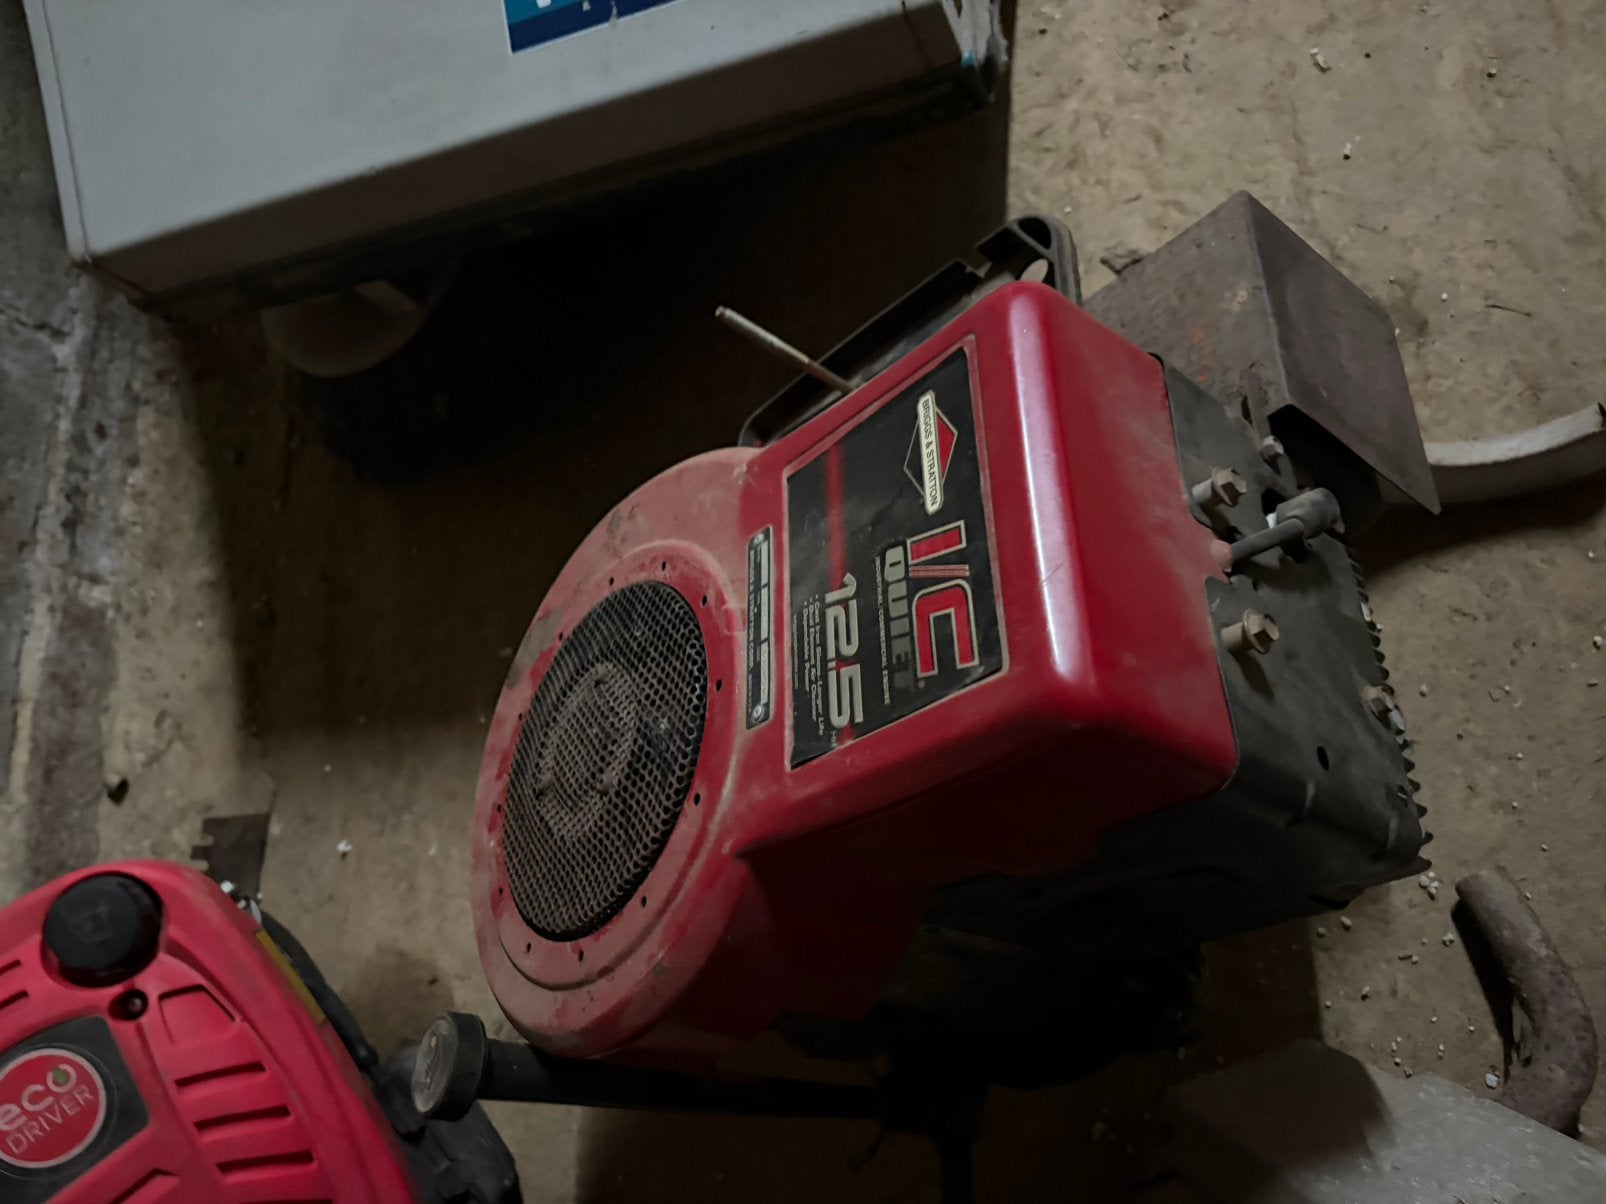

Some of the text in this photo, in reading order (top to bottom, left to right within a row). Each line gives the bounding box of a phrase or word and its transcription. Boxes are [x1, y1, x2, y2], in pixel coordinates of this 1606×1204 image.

[922, 398, 939, 506] BRIGGS & STRATTON
[884, 545, 914, 690] QUIET
[0, 1063, 78, 1132] eco
[5, 1084, 94, 1155] DRIVER
